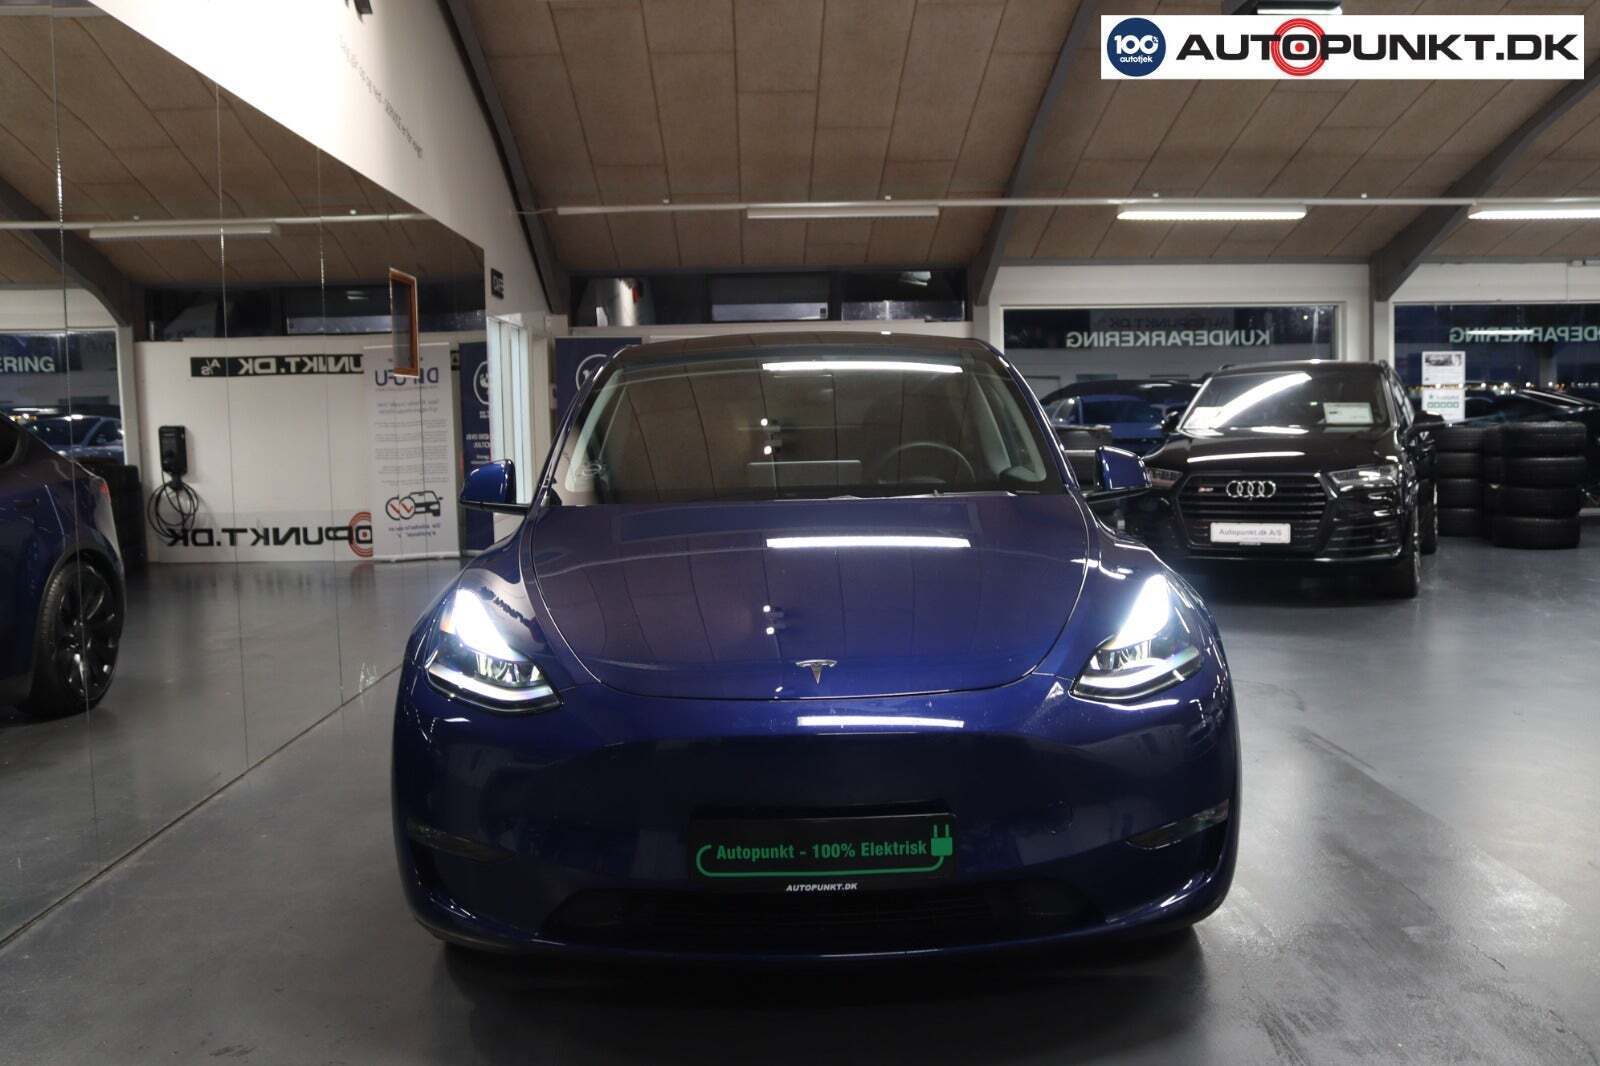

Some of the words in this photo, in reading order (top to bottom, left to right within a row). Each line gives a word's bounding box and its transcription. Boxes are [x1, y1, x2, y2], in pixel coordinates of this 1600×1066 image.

[0, 355, 55, 373] RING
[716, 844, 796, 862] Autopunkt
[811, 842, 857, 859] 100%
[860, 839, 928, 857] Elektrisk
[786, 882, 858, 892] AUTOPUNKT.DK
